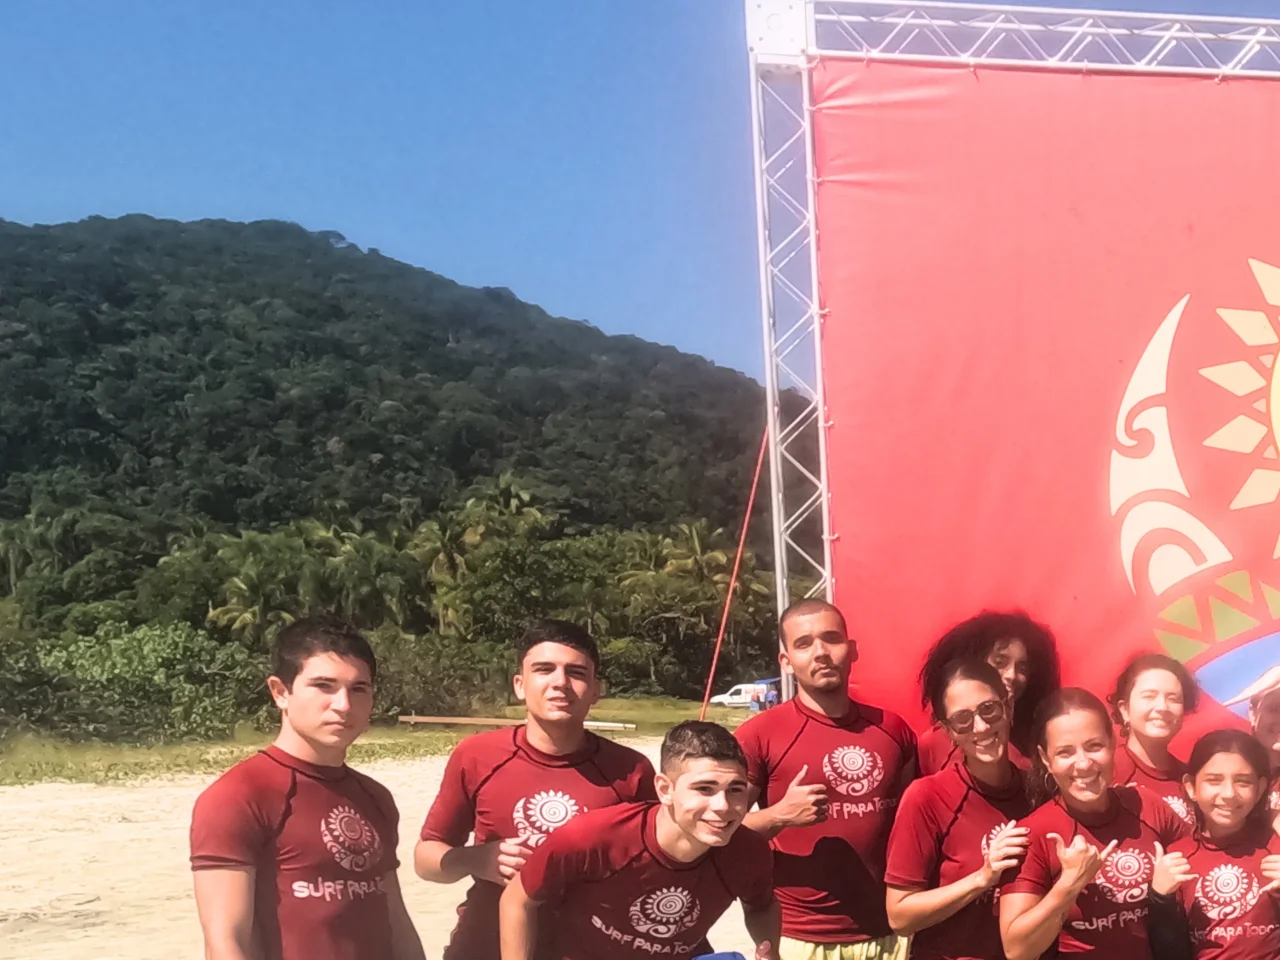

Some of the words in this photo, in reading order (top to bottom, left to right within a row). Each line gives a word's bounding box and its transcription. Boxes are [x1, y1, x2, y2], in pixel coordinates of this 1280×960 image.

[843, 802, 875, 819] PARA
[292, 876, 344, 901] SURF
[1071, 912, 1117, 932] SURF
[591, 915, 634, 945] SURF
[632, 937, 671, 955] PARA
[1211, 926, 1244, 942] PARA
